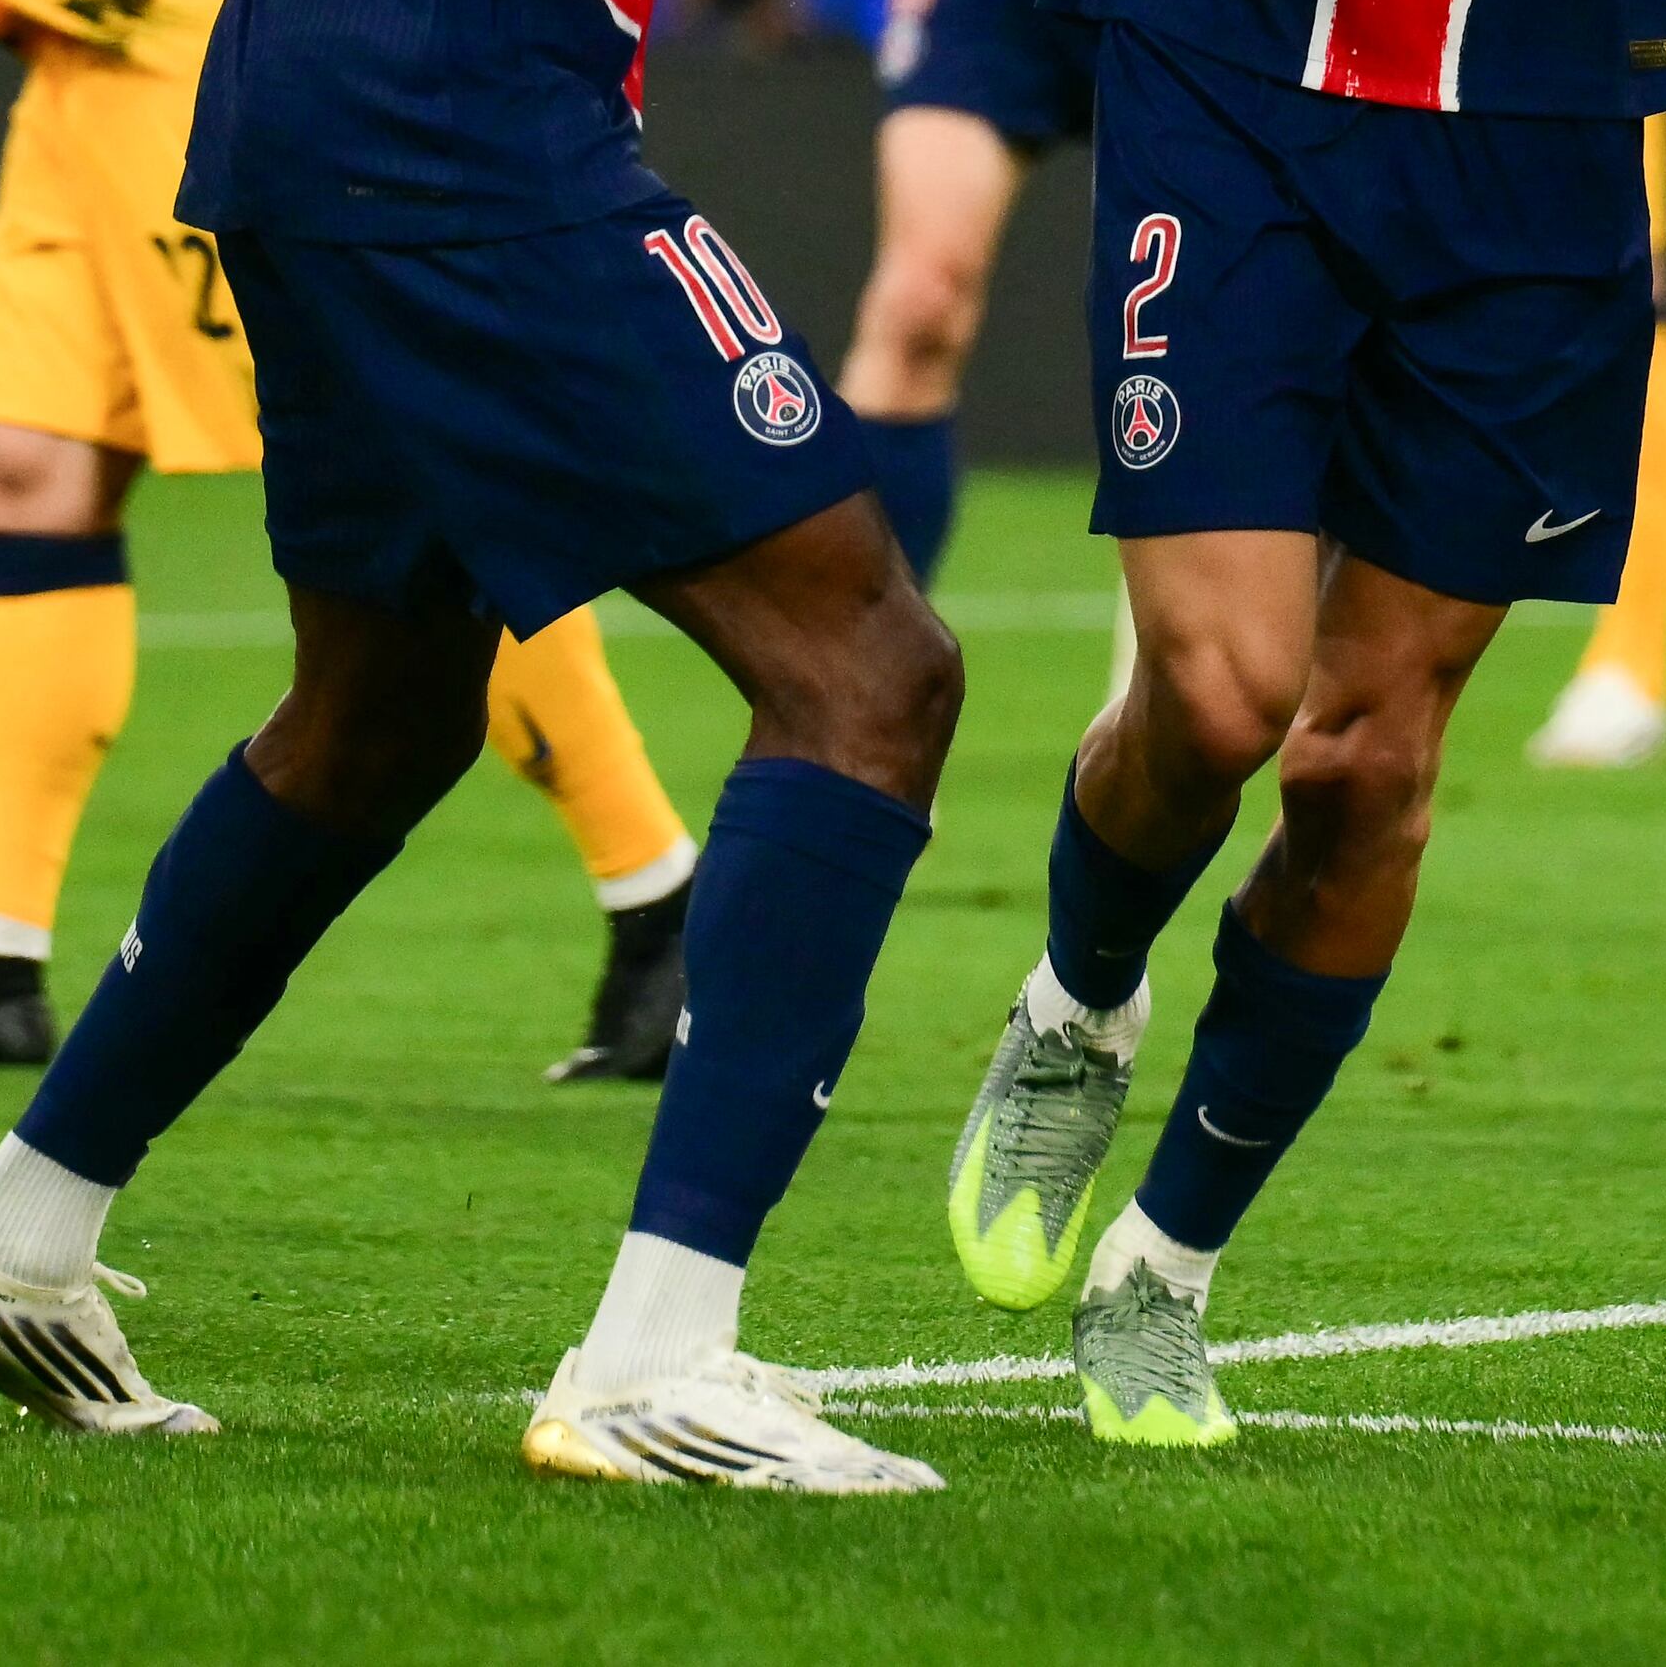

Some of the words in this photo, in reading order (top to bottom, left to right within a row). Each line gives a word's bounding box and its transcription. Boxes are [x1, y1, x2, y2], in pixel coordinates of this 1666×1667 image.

[644, 214, 782, 362] 10
[1123, 212, 1182, 361] 2
[740, 356, 790, 391] PARIS
[1118, 380, 1164, 405] PARIS
[764, 425, 789, 437] SAINT
